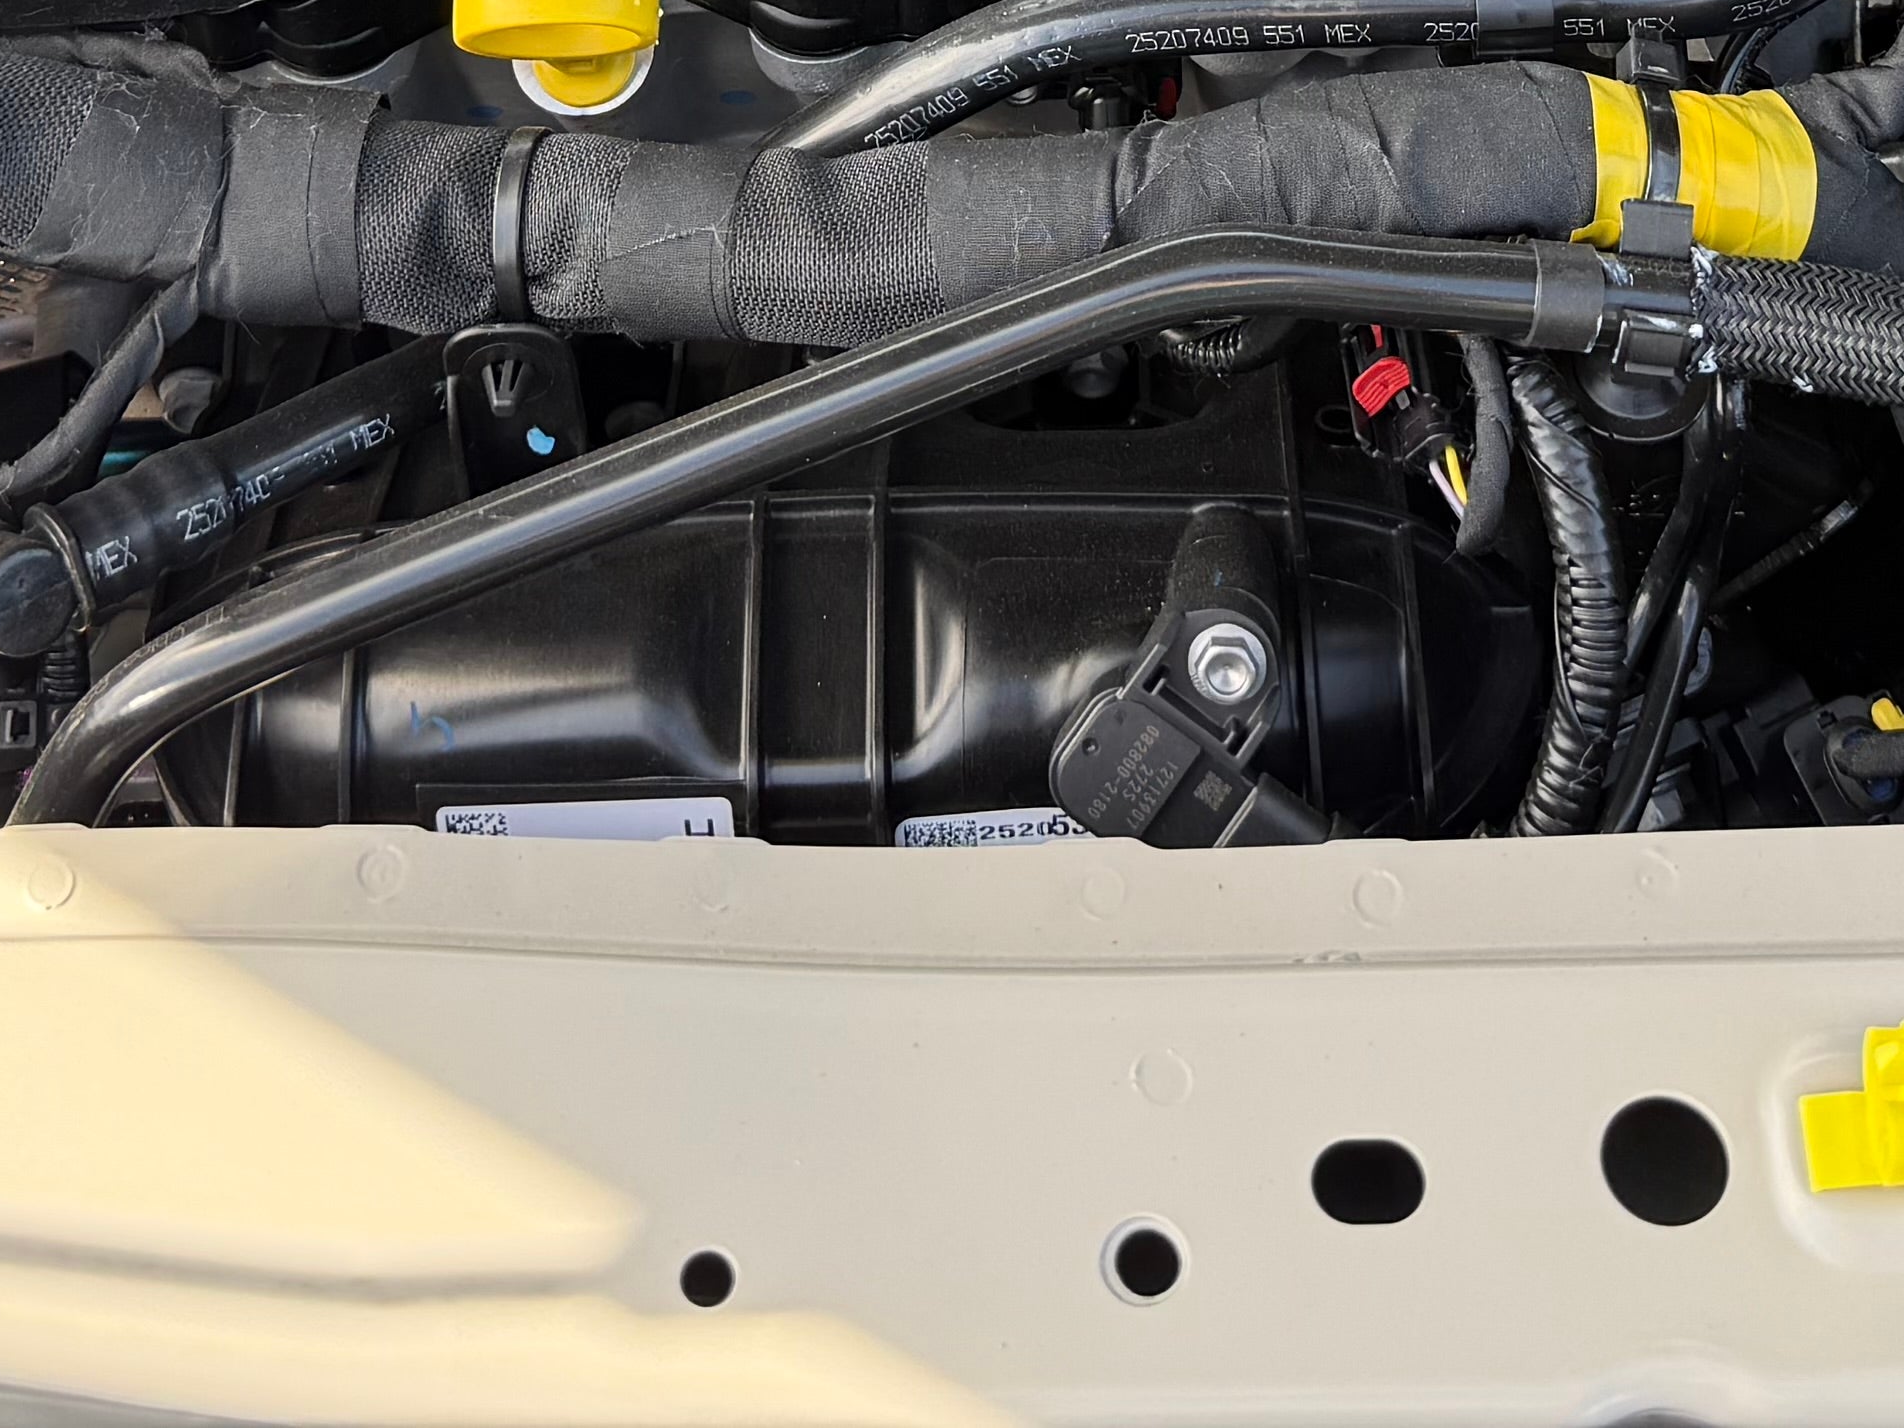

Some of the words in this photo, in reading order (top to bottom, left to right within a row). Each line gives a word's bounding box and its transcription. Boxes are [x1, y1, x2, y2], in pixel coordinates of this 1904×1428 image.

[1125, 26, 1250, 53] 25207409
[1263, 24, 1305, 46] 551
[1324, 23, 1373, 45] MEX
[1563, 18, 1605, 37] 551
[972, 65, 1019, 93] 551
[1028, 44, 1083, 72] MEX
[350, 412, 395, 451] MEX
